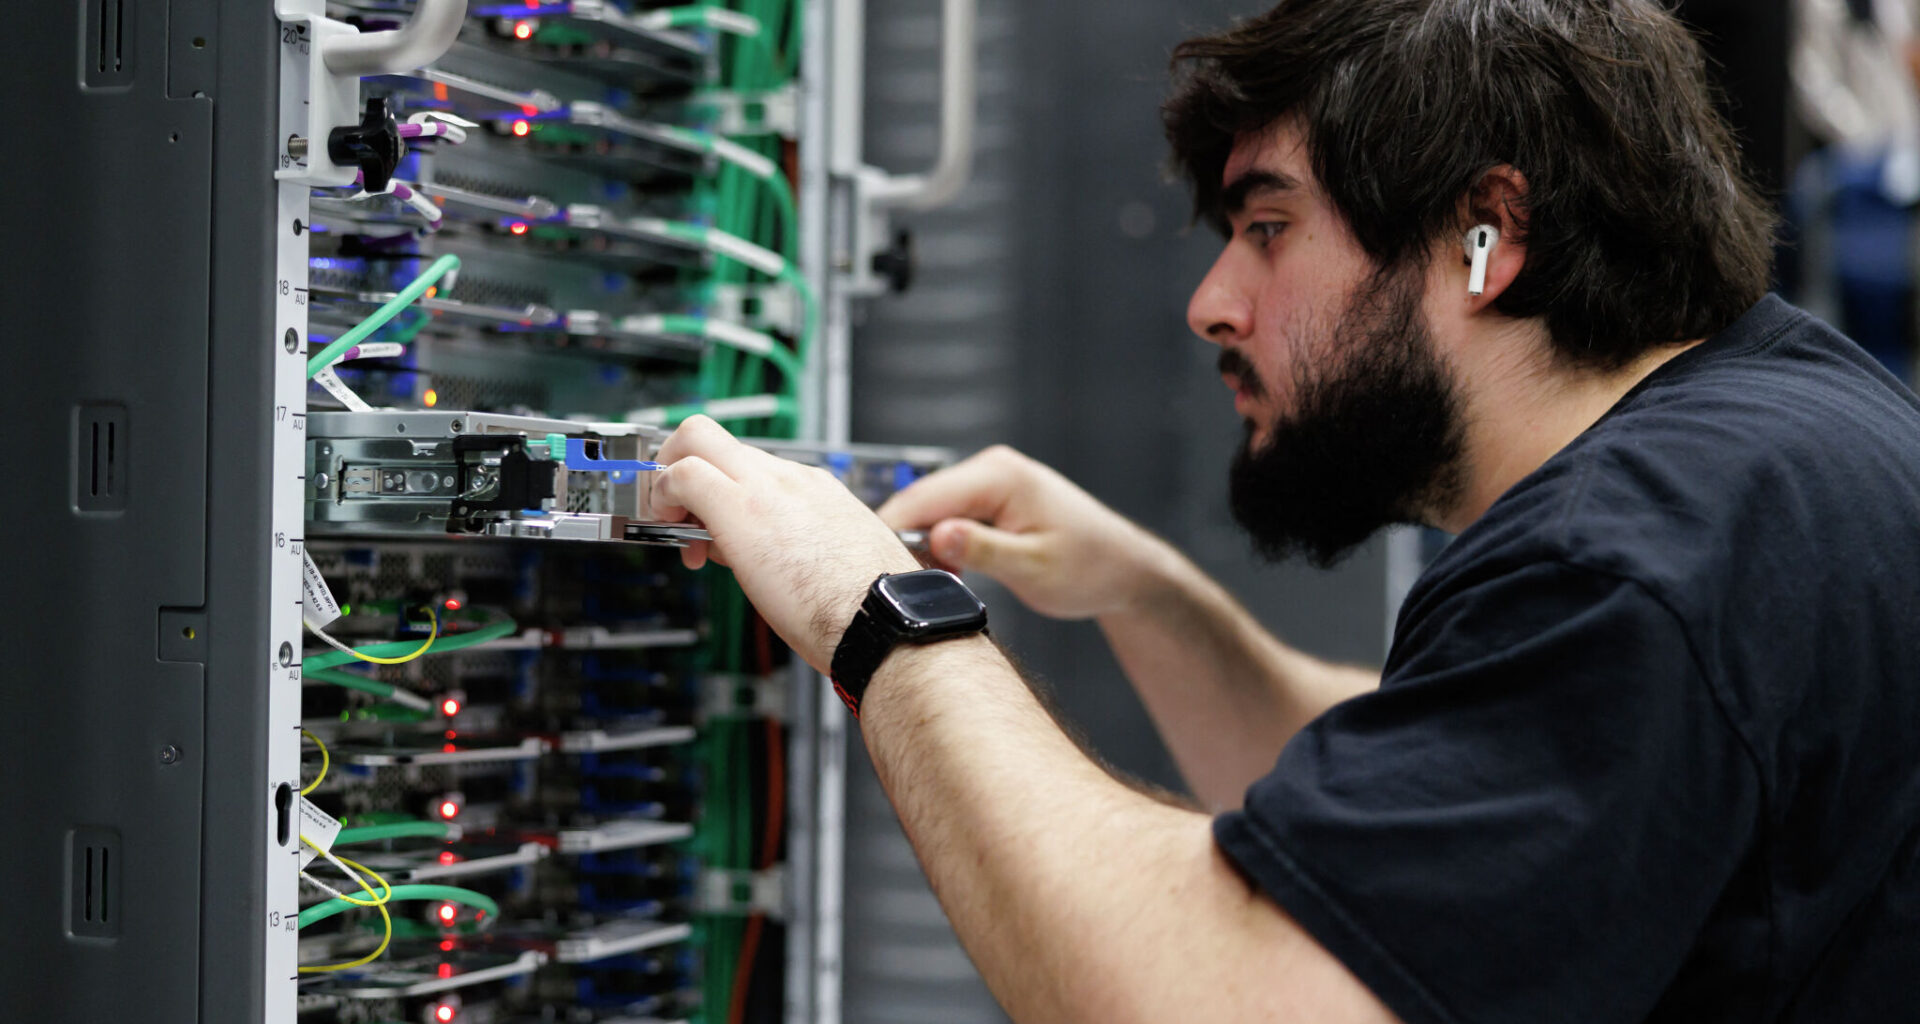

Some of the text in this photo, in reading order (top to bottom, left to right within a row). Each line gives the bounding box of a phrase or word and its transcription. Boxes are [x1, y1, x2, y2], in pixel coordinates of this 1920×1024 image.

[283, 27, 297, 45] 20
[281, 154, 290, 168] 19
[279, 279, 289, 296] 18
[295, 293, 306, 306] AU
[276, 405, 287, 421] 17
[292, 419, 304, 431] AU
[275, 531, 285, 548] 16
[290, 544, 301, 556] AU
[289, 669, 299, 681] AU
[269, 911, 280, 928] 13
[285, 920, 296, 933] AU
